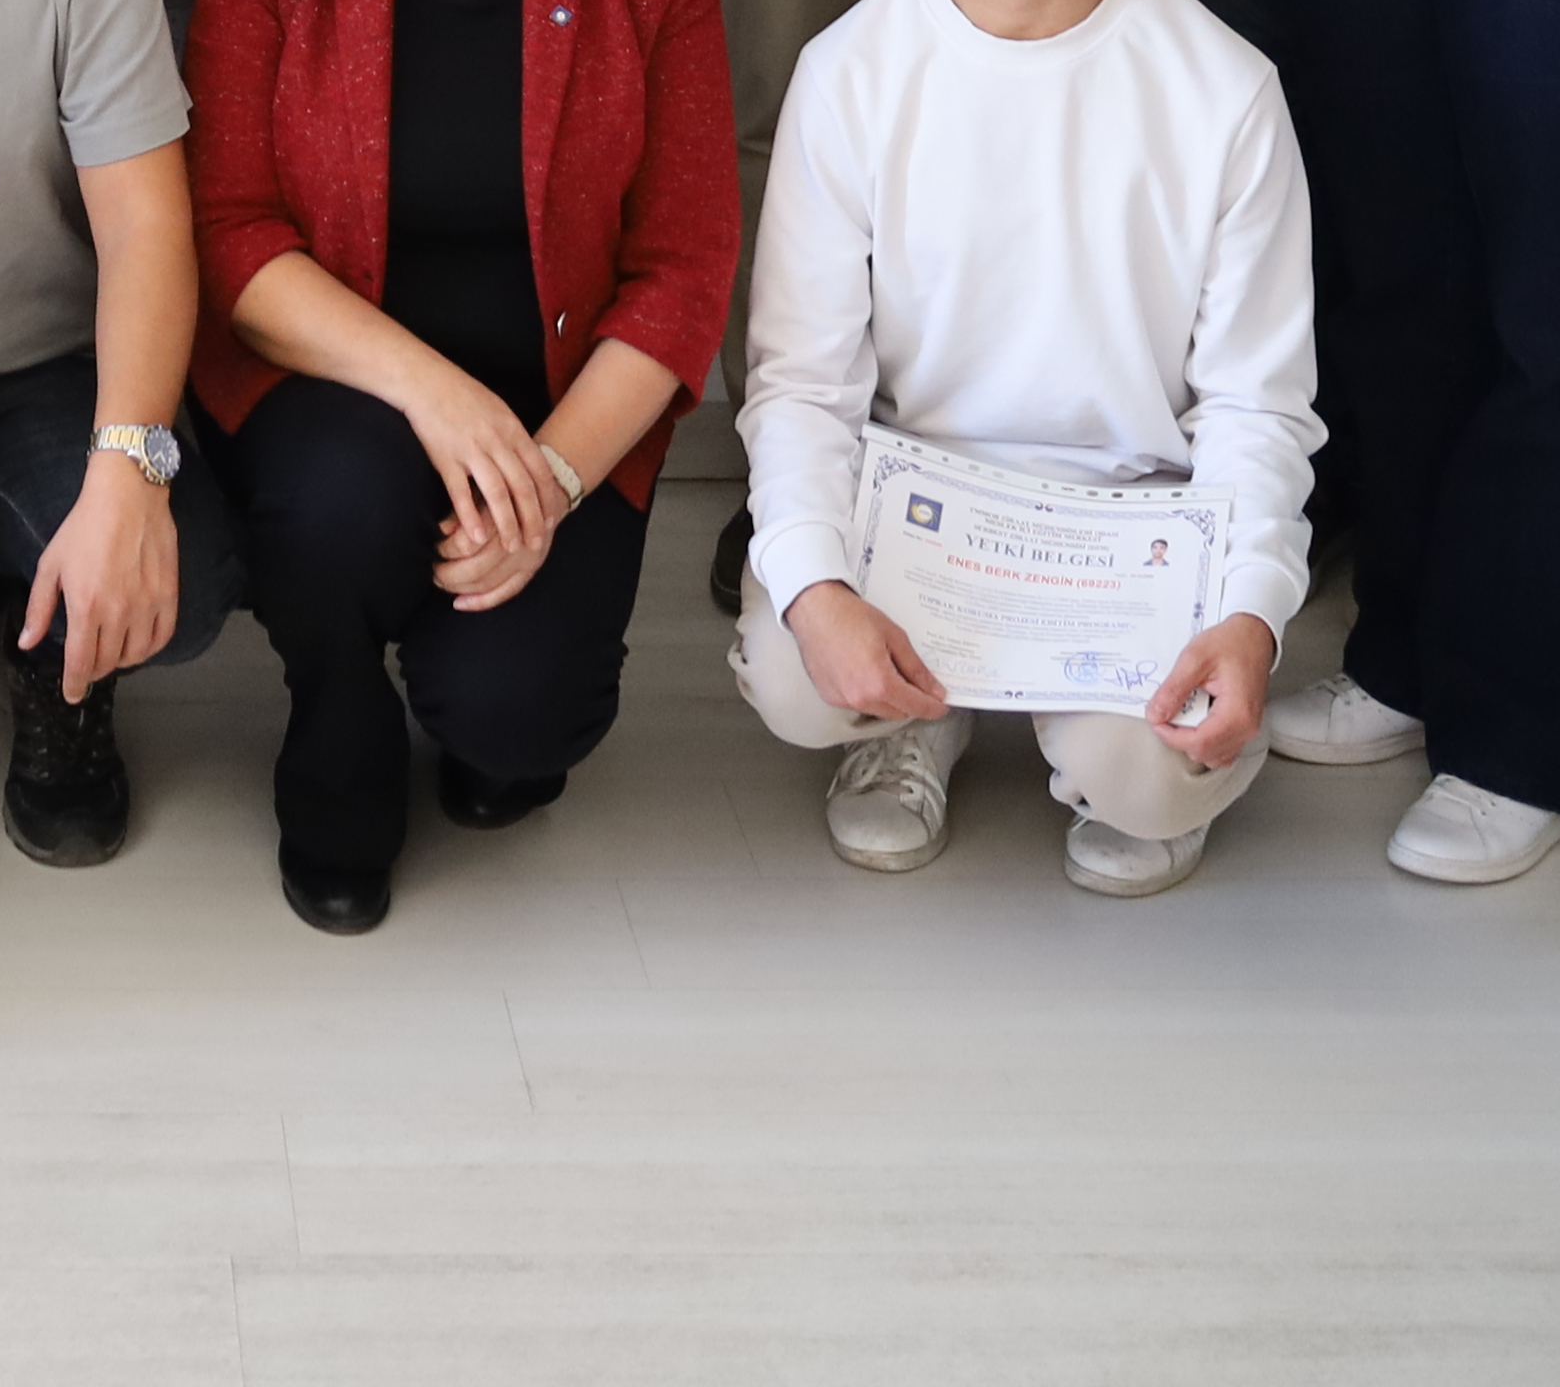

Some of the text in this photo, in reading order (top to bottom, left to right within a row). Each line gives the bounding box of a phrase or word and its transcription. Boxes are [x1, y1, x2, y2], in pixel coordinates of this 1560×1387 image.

[965, 533, 1115, 569] YETKİ BELGESİ
[947, 555, 982, 570] ENES
[985, 562, 1022, 581] BERK
[1025, 571, 1074, 589] ZENGİN
